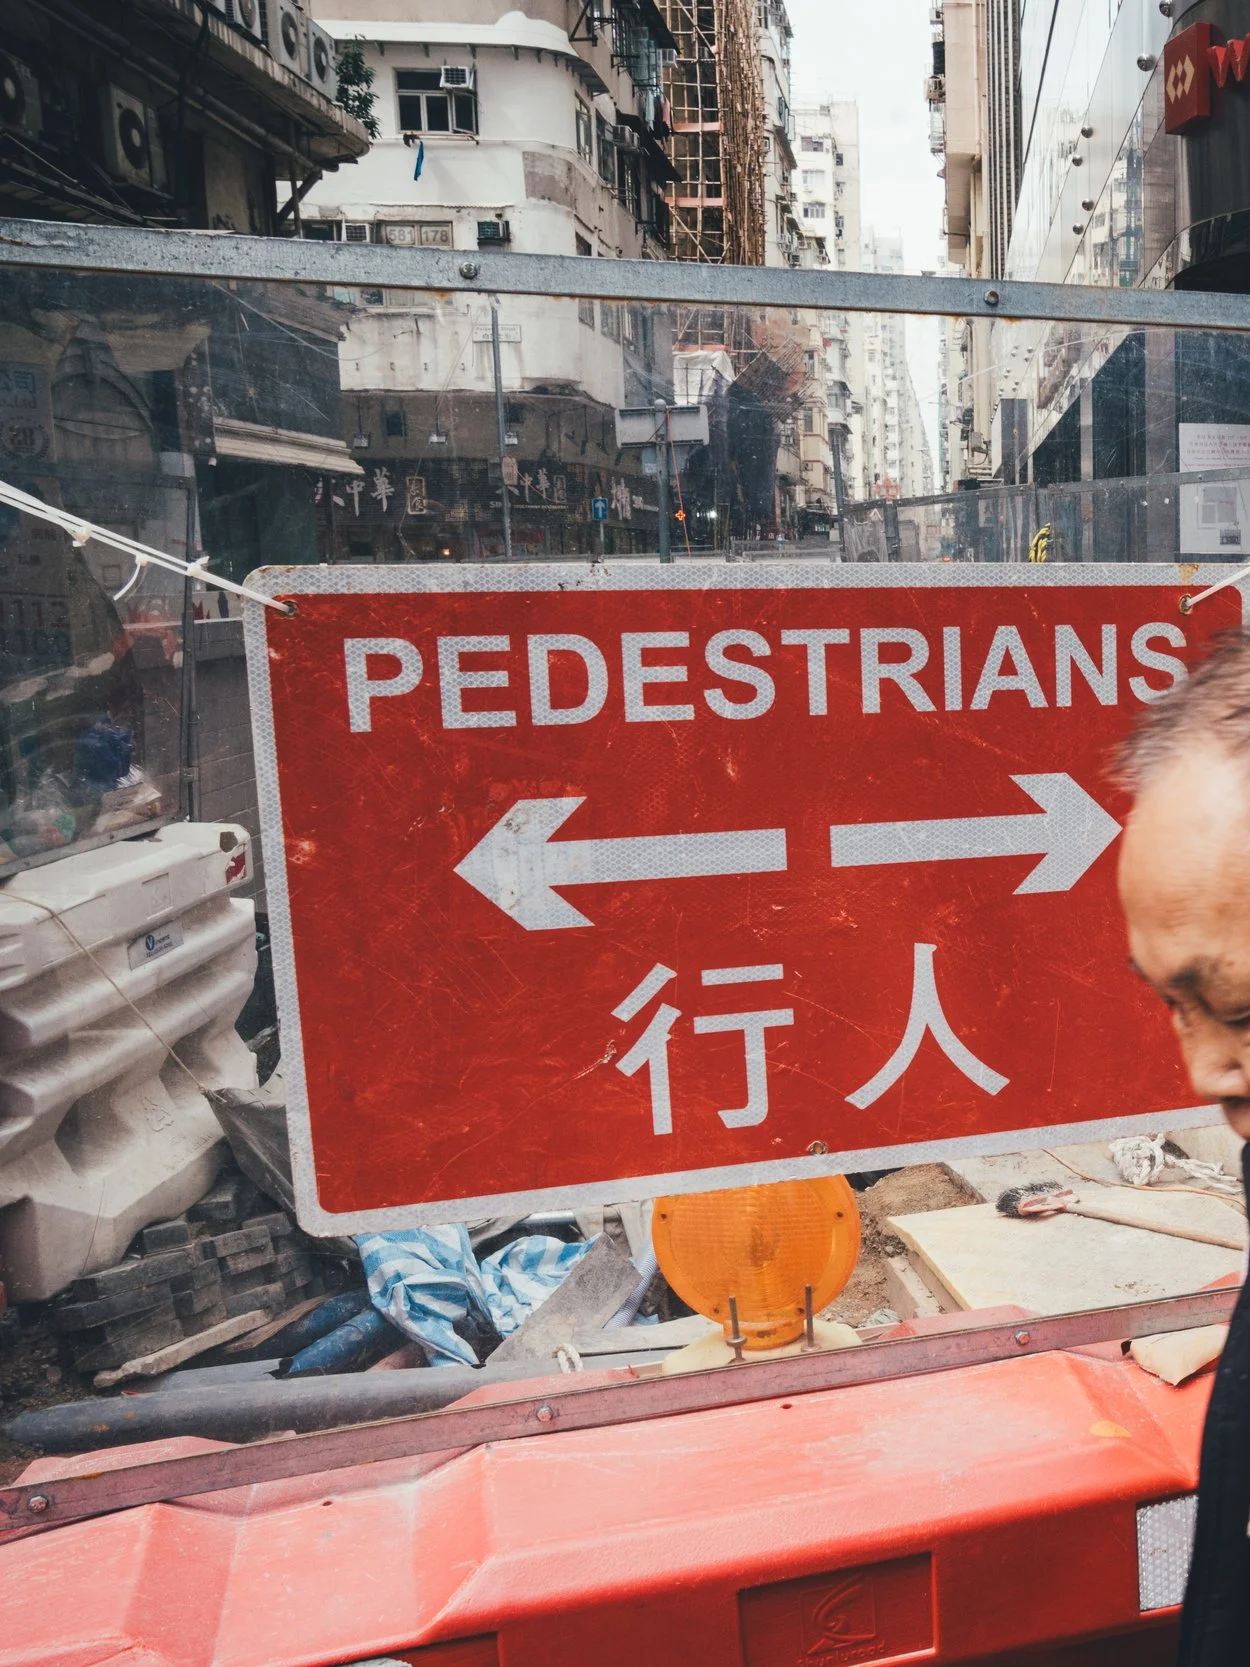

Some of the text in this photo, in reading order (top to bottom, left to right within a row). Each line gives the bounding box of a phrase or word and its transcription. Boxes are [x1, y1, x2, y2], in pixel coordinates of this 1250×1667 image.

[423, 229, 449, 242] 178
[343, 621, 1189, 734] PEDESTRIANS
[611, 942, 1010, 1136] 行人
